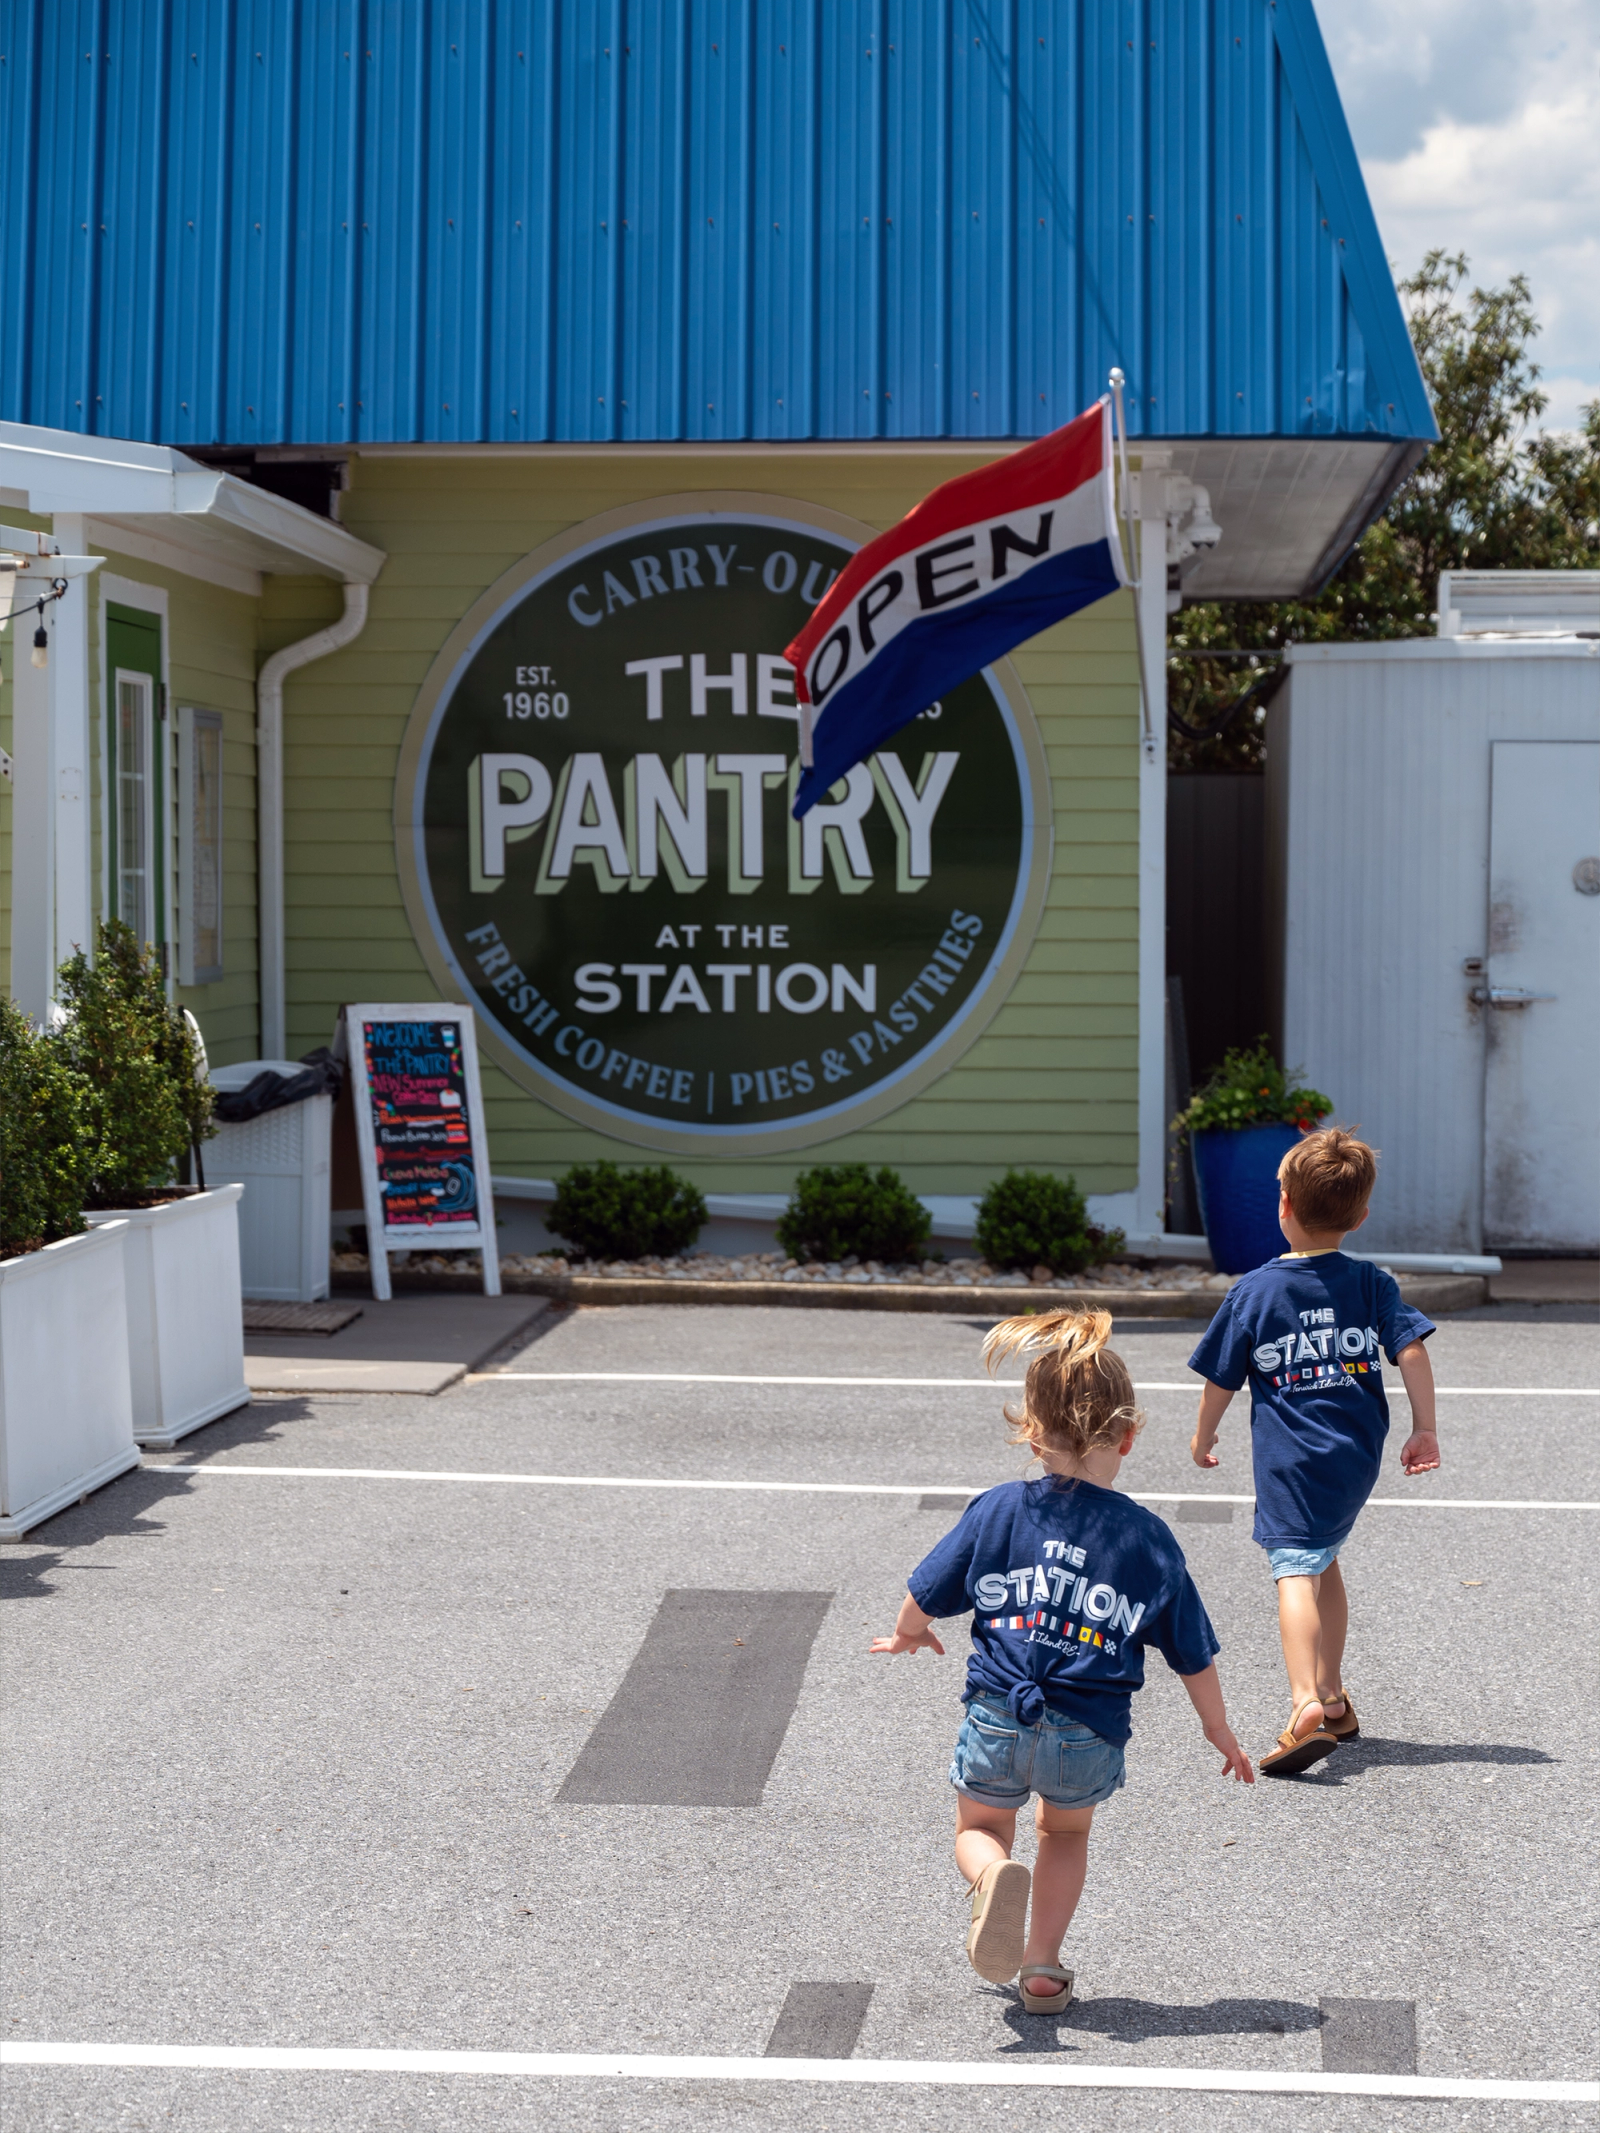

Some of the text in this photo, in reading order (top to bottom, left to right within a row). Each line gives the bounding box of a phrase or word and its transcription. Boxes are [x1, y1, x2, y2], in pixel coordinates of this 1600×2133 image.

[567, 544, 839, 627] CARRY-OU
[811, 510, 1054, 707] OPEN
[515, 667, 556, 685] EST.
[624, 652, 798, 720] THE
[502, 692, 569, 719] 1960
[467, 751, 960, 895] PANTRY
[655, 925, 789, 948] AT THE
[574, 963, 877, 1013] STATION
[730, 908, 983, 1106] PIES & PASTRIES
[465, 922, 694, 1104] FRESH COFFEE
[374, 1052, 450, 1075] THE PANTRY
[373, 1073, 449, 1093] NEW Summer
[1299, 1307, 1335, 1327] THE
[1253, 1325, 1379, 1373] STATION
[1318, 1376, 1344, 1390] Island
[1043, 1540, 1087, 1569] THE
[974, 1564, 1146, 1636] STATION
[1061, 1640, 1078, 1657] DE
